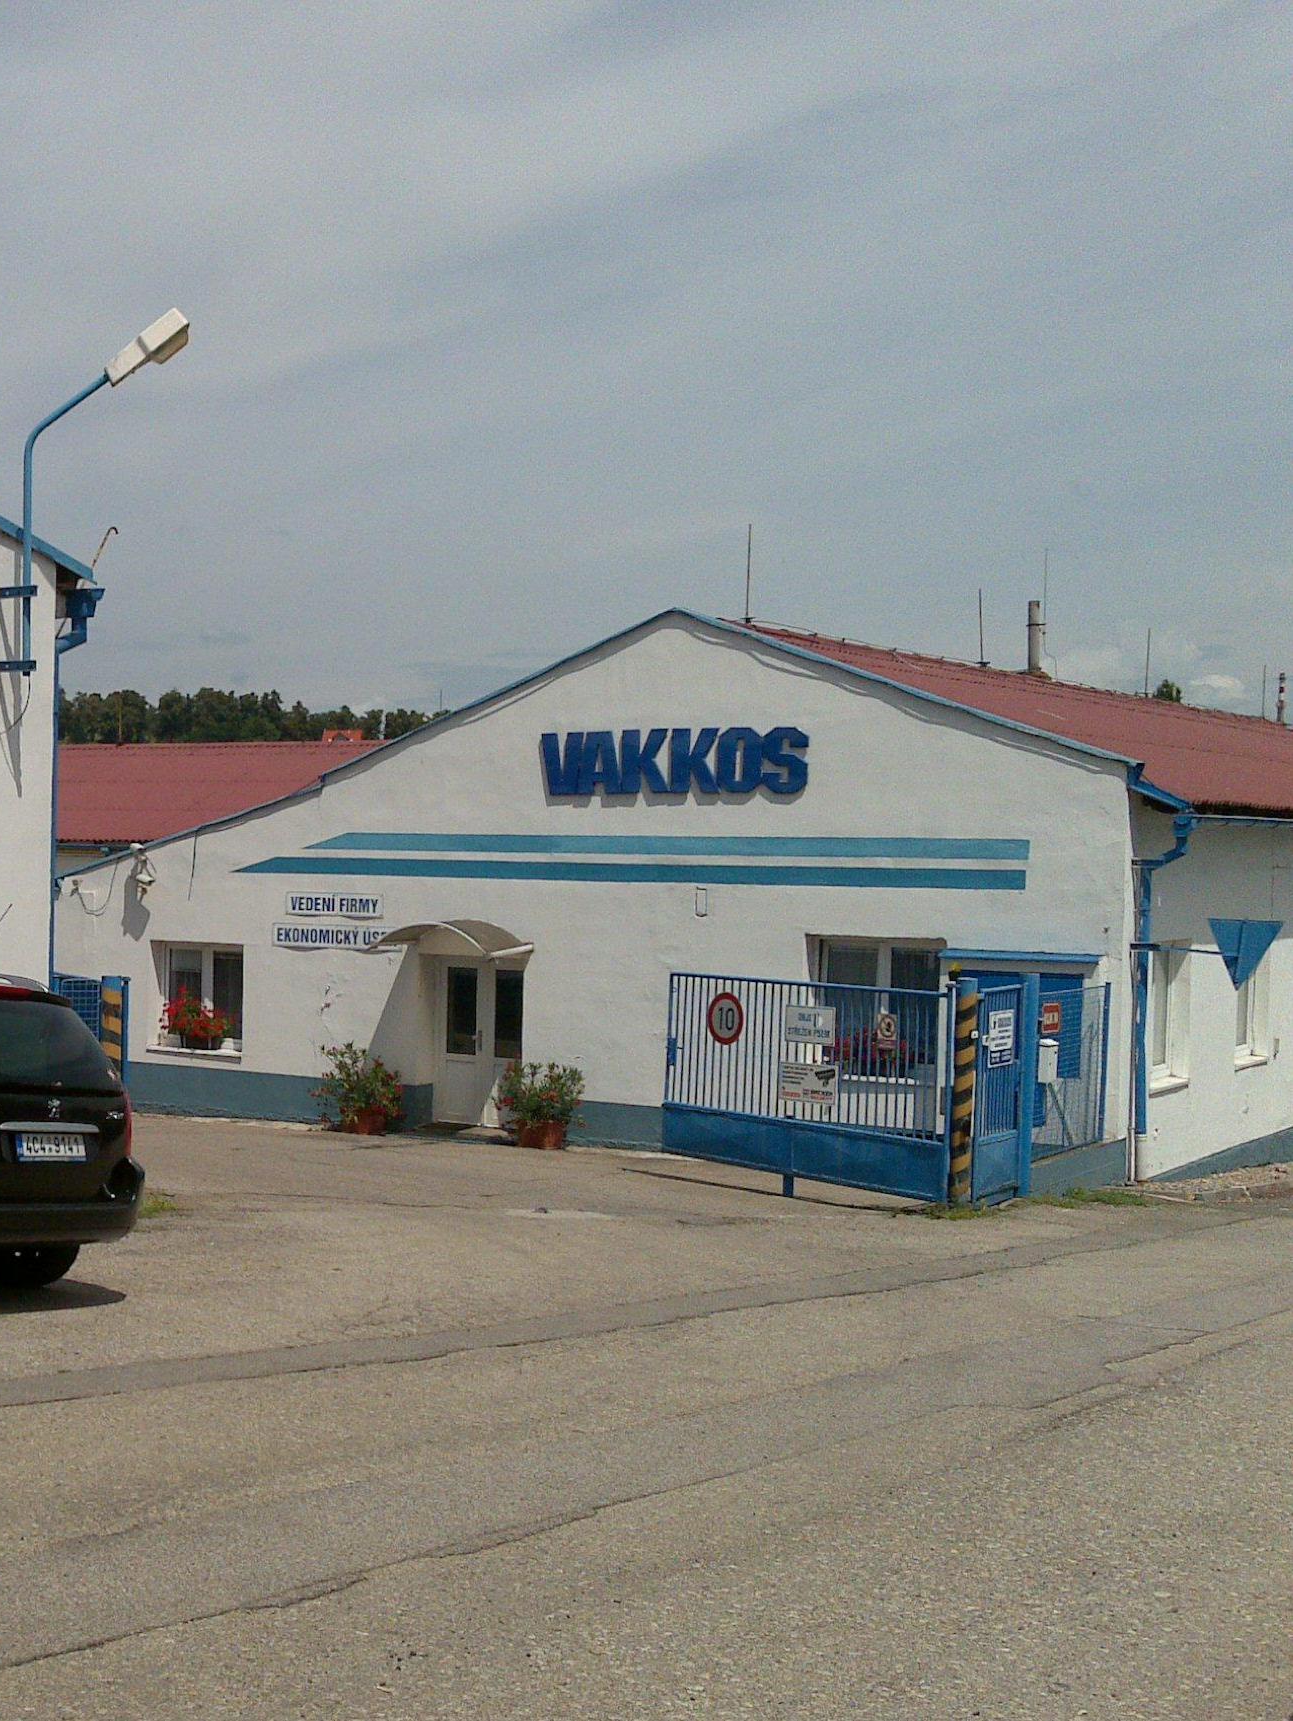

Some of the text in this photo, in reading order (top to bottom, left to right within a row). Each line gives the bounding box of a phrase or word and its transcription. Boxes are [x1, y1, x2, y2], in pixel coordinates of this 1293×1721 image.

[541, 727, 809, 796] VAKKOS
[290, 893, 378, 914] VEDENÍ FIRMY
[276, 926, 359, 945] EKONOMICKÝ
[718, 1007, 734, 1030] 10
